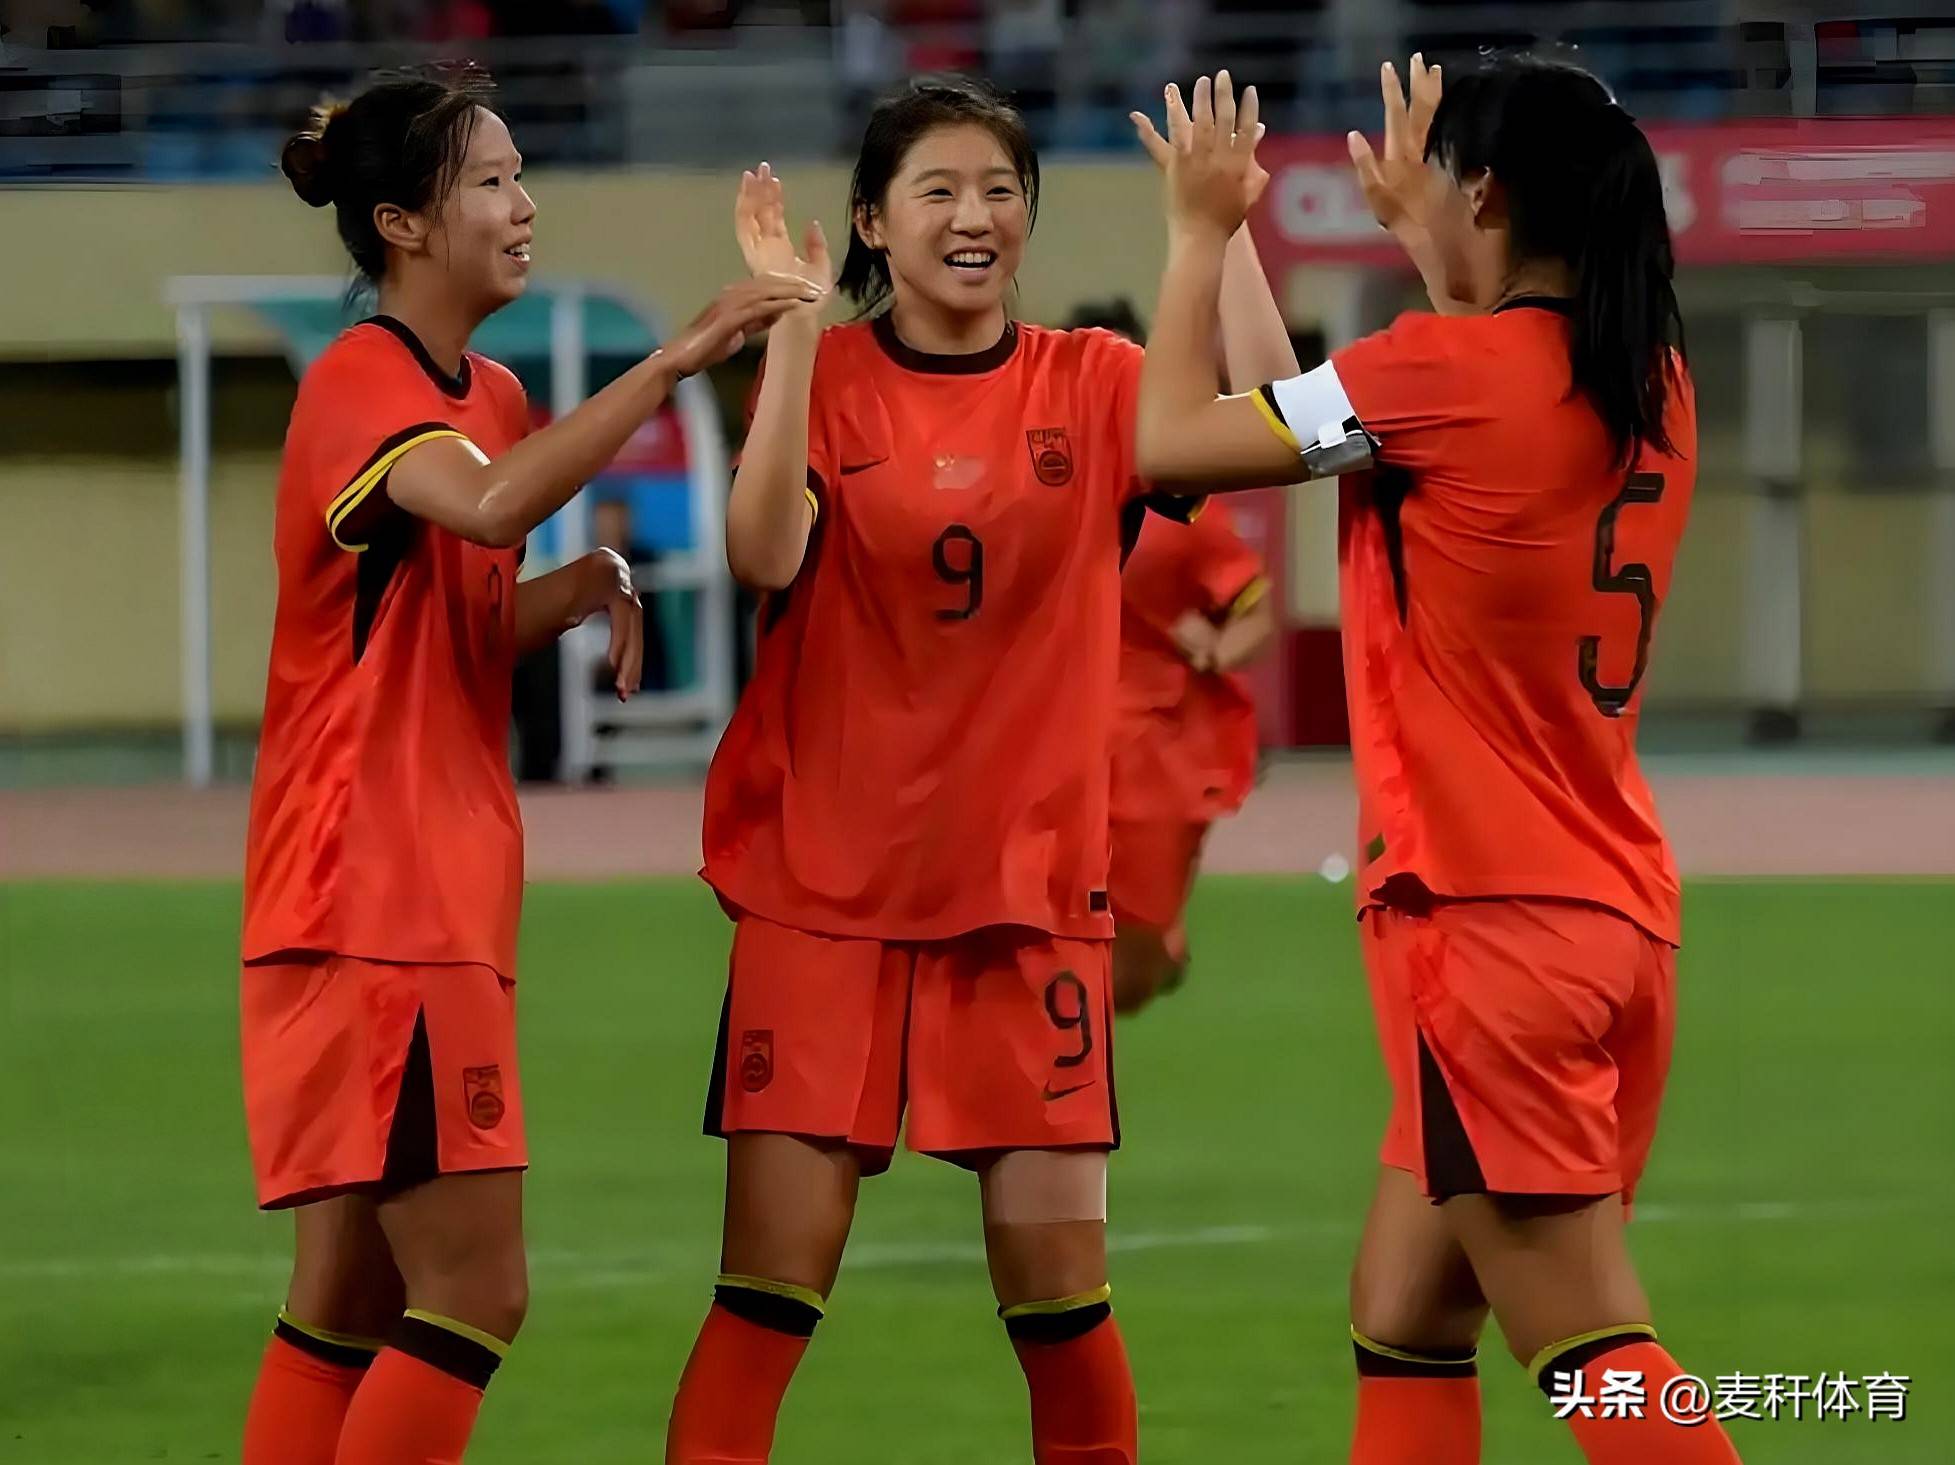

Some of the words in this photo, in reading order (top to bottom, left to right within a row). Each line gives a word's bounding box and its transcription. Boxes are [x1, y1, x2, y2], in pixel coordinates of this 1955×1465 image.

[932, 523, 985, 622] 9
[1577, 472, 1664, 718] 5
[1044, 971, 1094, 1068] 9
